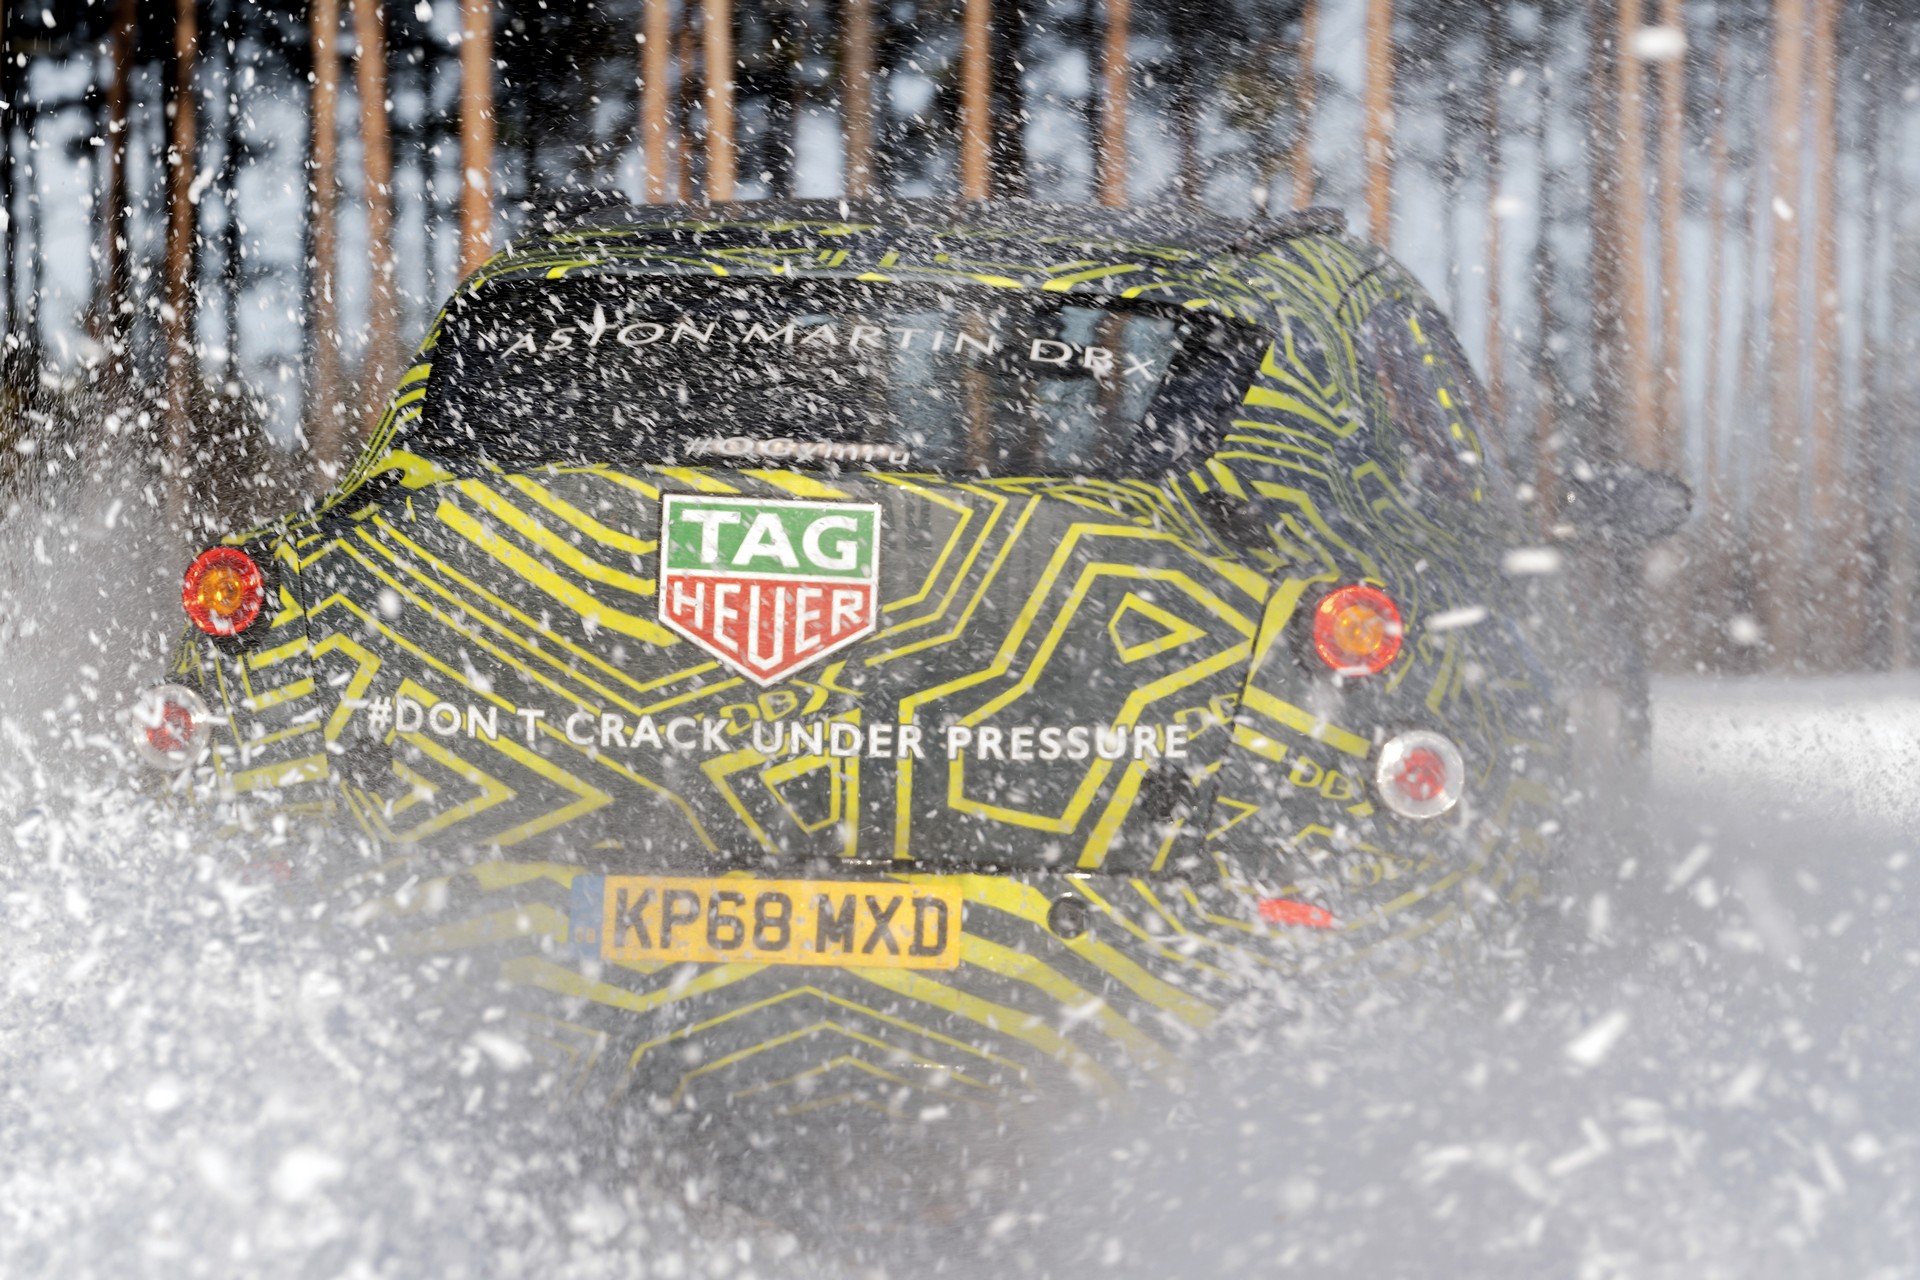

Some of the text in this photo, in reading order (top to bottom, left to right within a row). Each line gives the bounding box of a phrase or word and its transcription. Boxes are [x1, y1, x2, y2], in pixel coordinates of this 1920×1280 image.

[500, 321, 1155, 381] ASTON MARTIN DBX
[681, 509, 859, 570] TAG
[673, 582, 863, 670] HEUER
[566, 709, 730, 752] CRACK
[753, 720, 925, 758] UNDER
[947, 725, 1188, 761] PRESSURE
[614, 888, 948, 957] KP68 MXD
